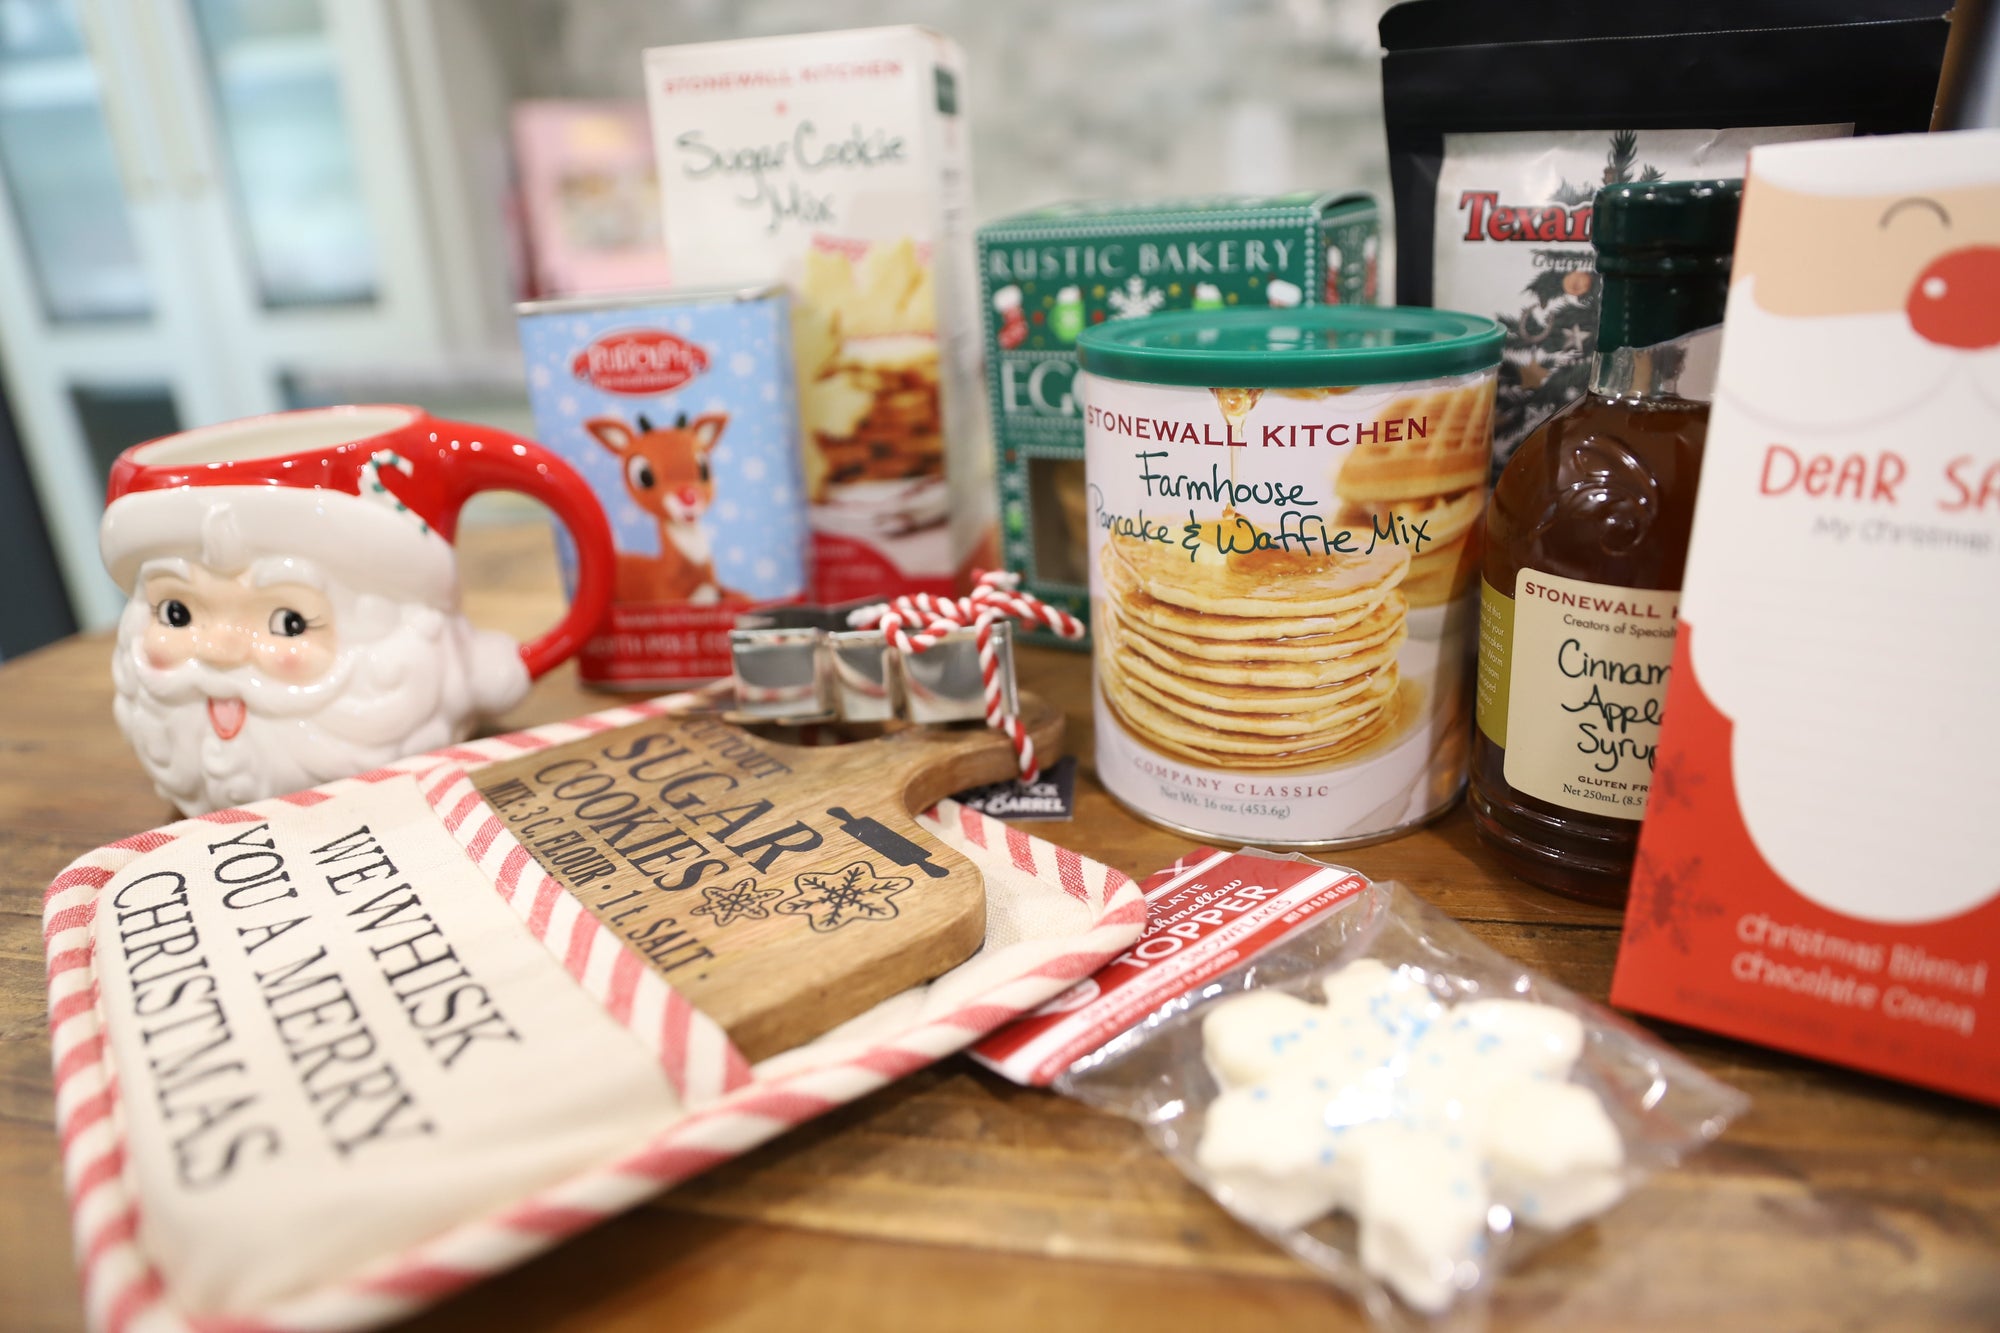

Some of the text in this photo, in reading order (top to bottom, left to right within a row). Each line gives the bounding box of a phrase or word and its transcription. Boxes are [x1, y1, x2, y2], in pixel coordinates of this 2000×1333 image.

[674, 120, 908, 204] Sugar Cookie
[764, 182, 836, 235] Mix
[989, 239, 1295, 281] RUSTIC BAKERY
[1087, 405, 1247, 448] STONEWALL
[1262, 415, 1429, 448] KITCHEN
[1135, 450, 1318, 507] Farmhouse
[1089, 482, 1432, 563] Pancake & Waffle Mix
[1525, 581, 1661, 619] STONEWALL
[1563, 613, 1611, 633] Creators
[1613, 622, 1627, 635] of
[602, 732, 825, 876] SUGAR
[1133, 756, 1330, 798] COMPANY CLASSIC
[1563, 783, 1643, 807] Net 250mL (8.5
[1577, 776, 1652, 793] GLUTEN FR
[534, 758, 731, 892] COOKIES
[1204, 797, 1218, 812] 16
[1219, 802, 1238, 814] oz.
[1239, 803, 1291, 819] (453.6g)
[533, 829, 618, 889] FLOUR
[309, 824, 523, 1070] WE WHISK
[1109, 885, 1279, 969] TOPPER
[207, 823, 437, 1163] YOU A MERRY
[112, 869, 284, 1193] CHRISTMAS
